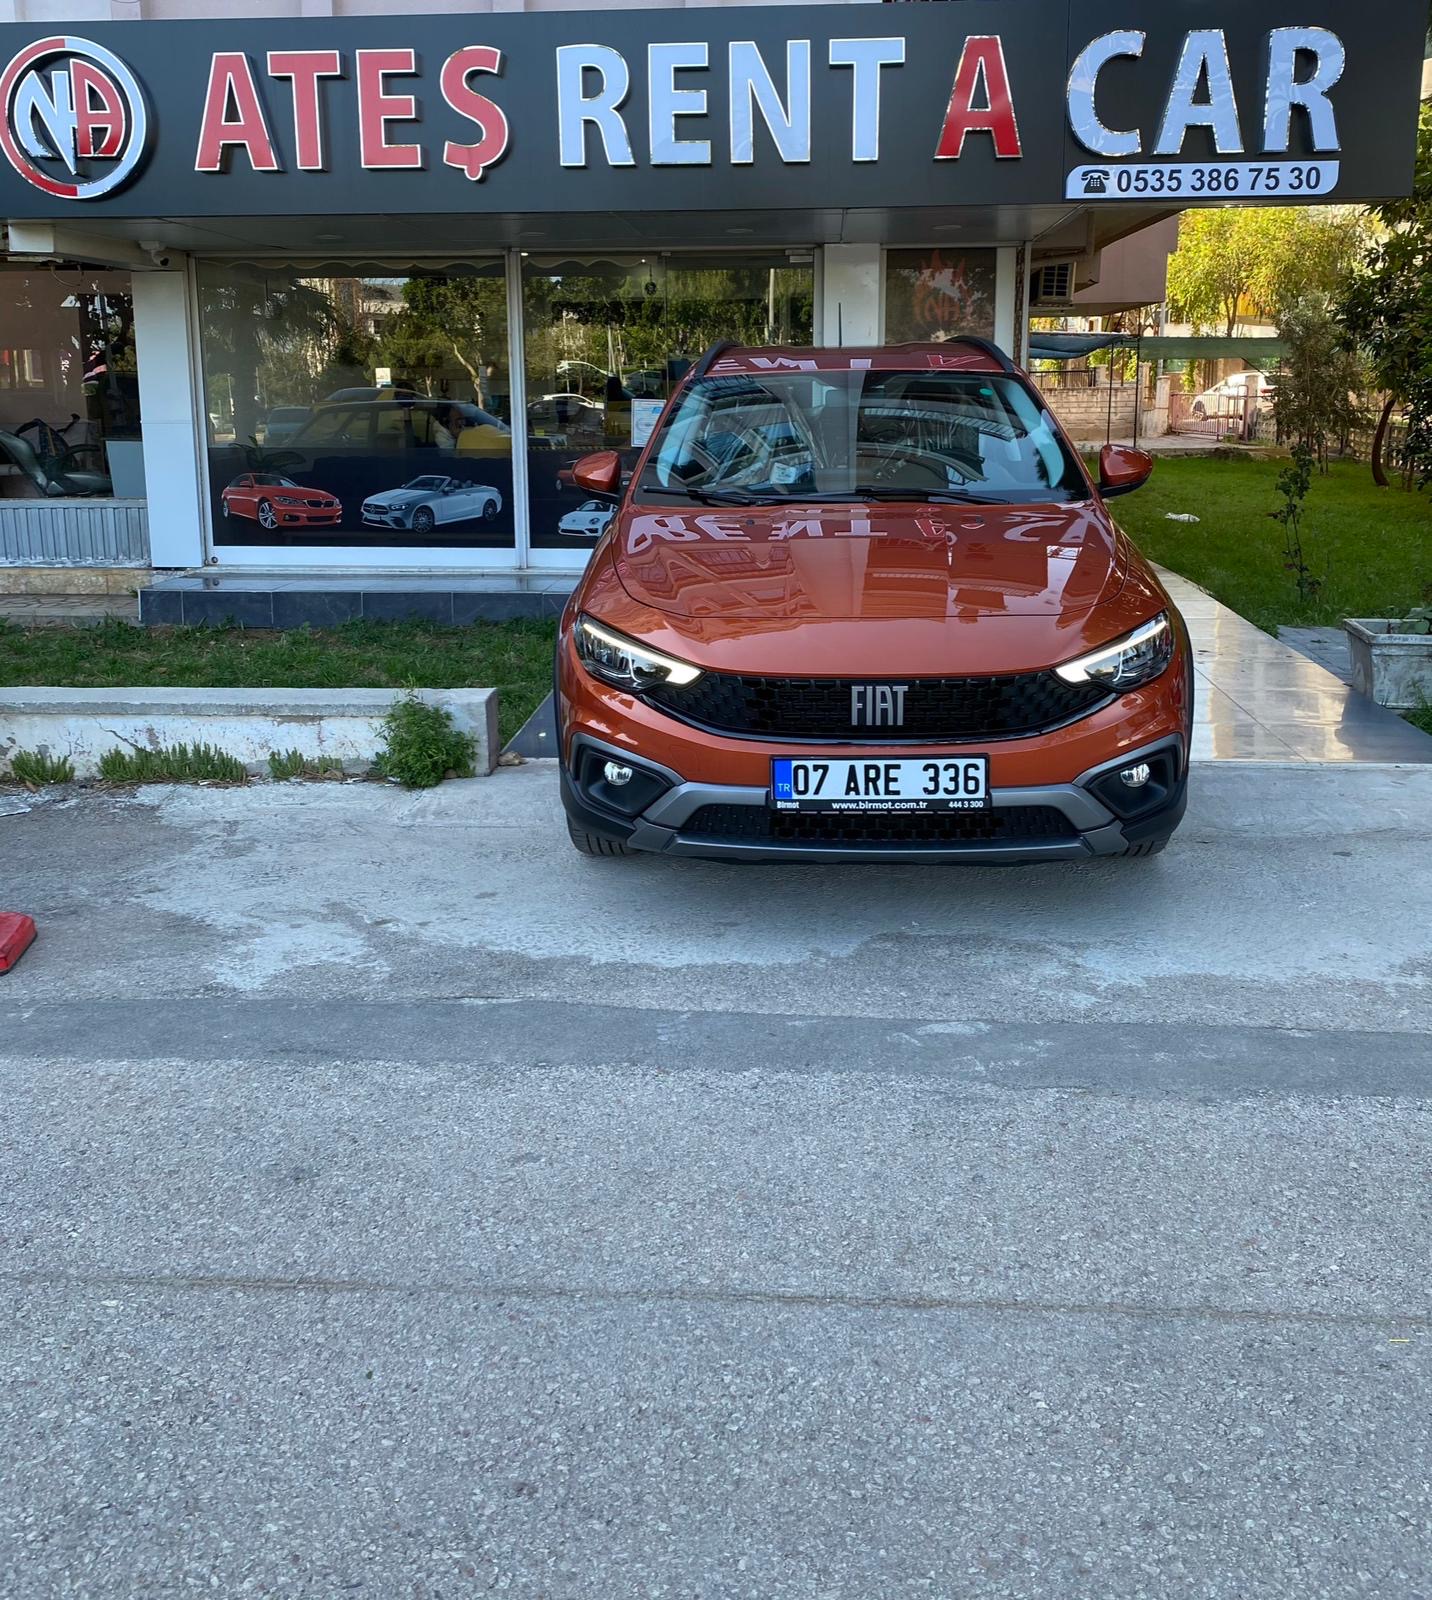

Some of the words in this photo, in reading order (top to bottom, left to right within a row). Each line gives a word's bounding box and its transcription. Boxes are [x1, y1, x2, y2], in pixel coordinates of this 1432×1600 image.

[194, 45, 509, 181] ATEŞ
[556, 37, 905, 167] RENT
[934, 34, 1023, 160] A
[1066, 26, 1346, 157] CAR
[1117, 169, 1182, 193] 0535
[1190, 168, 1239, 192] 386
[1248, 167, 1280, 191] 75
[1289, 166, 1321, 190] 30
[851, 685, 909, 726] FIAT
[777, 783, 791, 793] TR
[793, 764, 829, 795] 07
[844, 764, 901, 796] ARE
[922, 763, 980, 795] 336
[776, 801, 800, 809] Birmot
[831, 801, 928, 810] www.birmot.com.tr
[948, 801, 962, 809] 444
